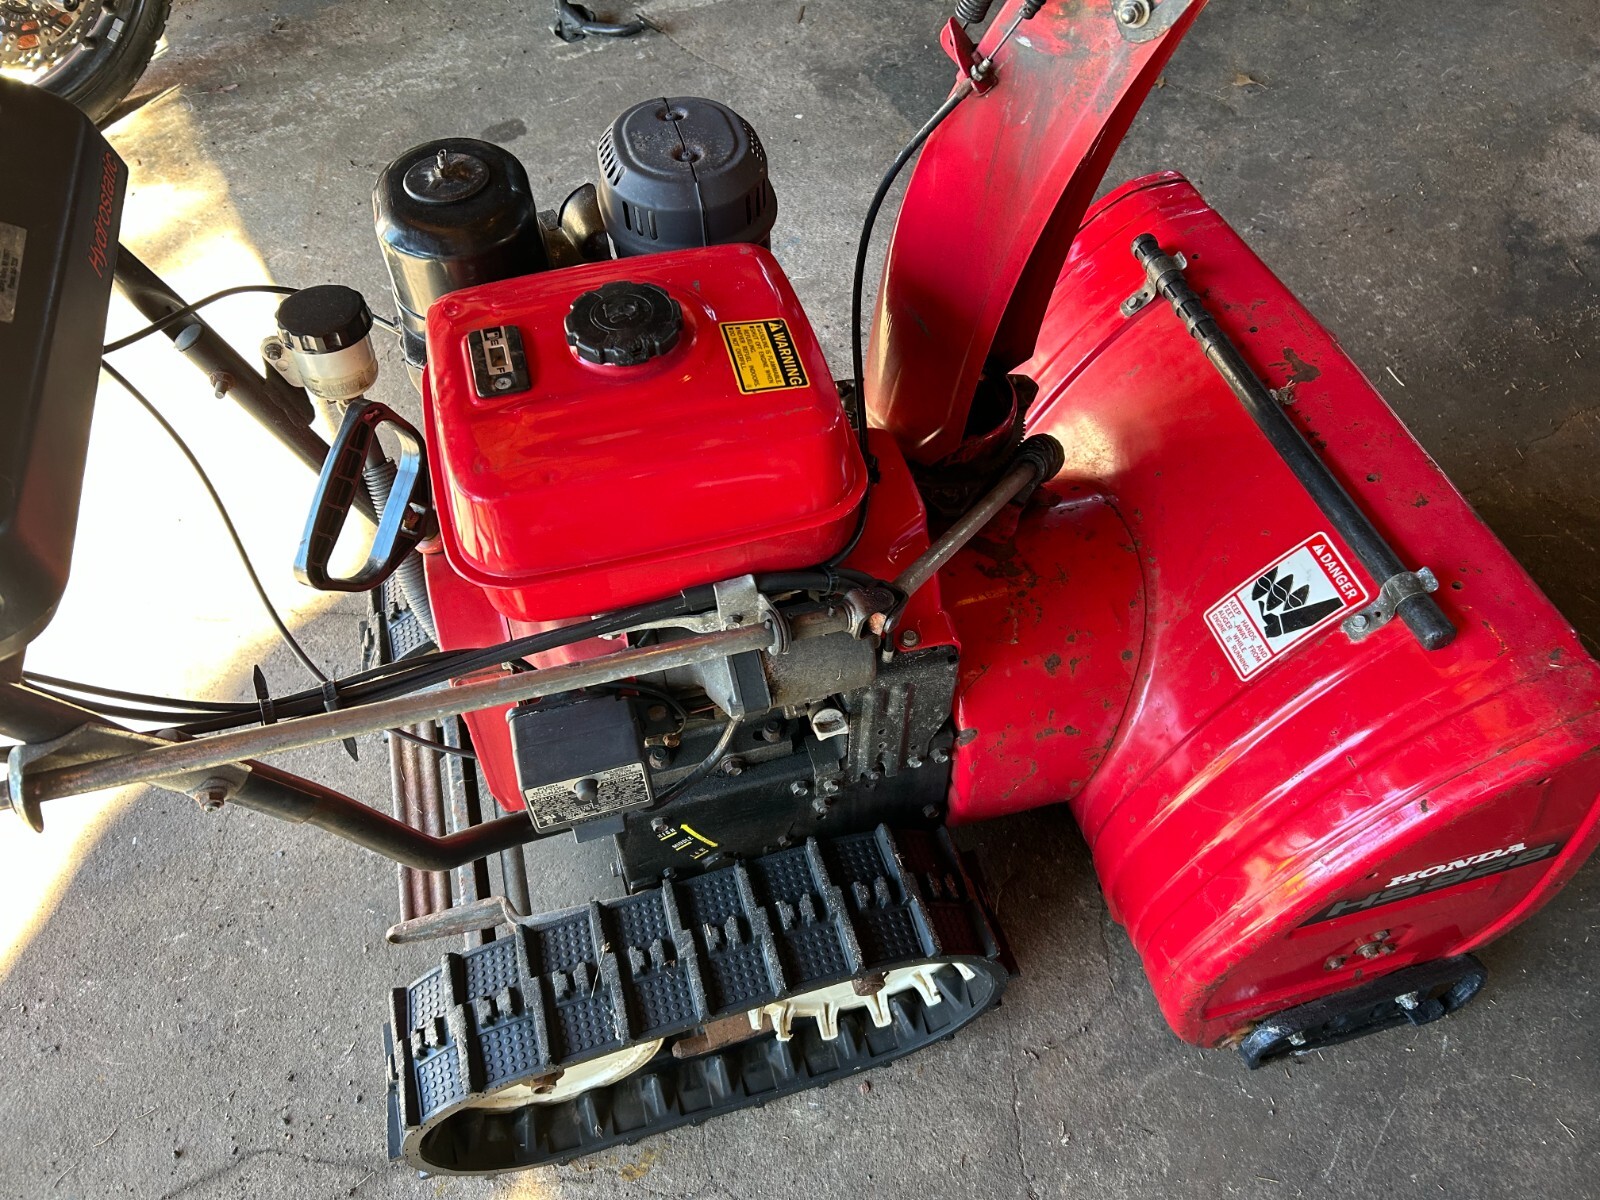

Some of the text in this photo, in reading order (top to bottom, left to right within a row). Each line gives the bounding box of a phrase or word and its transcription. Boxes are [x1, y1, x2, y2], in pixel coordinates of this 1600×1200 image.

[88, 151, 118, 279] Hydrostatic
[736, 330, 746, 344] NEVER
[742, 346, 752, 362] REFUEL
[750, 328, 759, 339] SHUT
[759, 352, 769, 368] ENGINE
[765, 370, 774, 383] WHEN
[757, 328, 769, 348] GASOLINE
[773, 332, 803, 385] WARNING
[1320, 553, 1358, 600] DANGER
[1211, 613, 1227, 634] ENGINE
[1230, 644, 1251, 672] RUNNING.
[1218, 610, 1248, 653] AUGER WHILE
[1223, 604, 1262, 663] FEET AWAY FROM
[1228, 600, 1268, 659] KEEP HANDS AND
[657, 828, 676, 838] HIGH
[1385, 843, 1528, 888] HONDA
